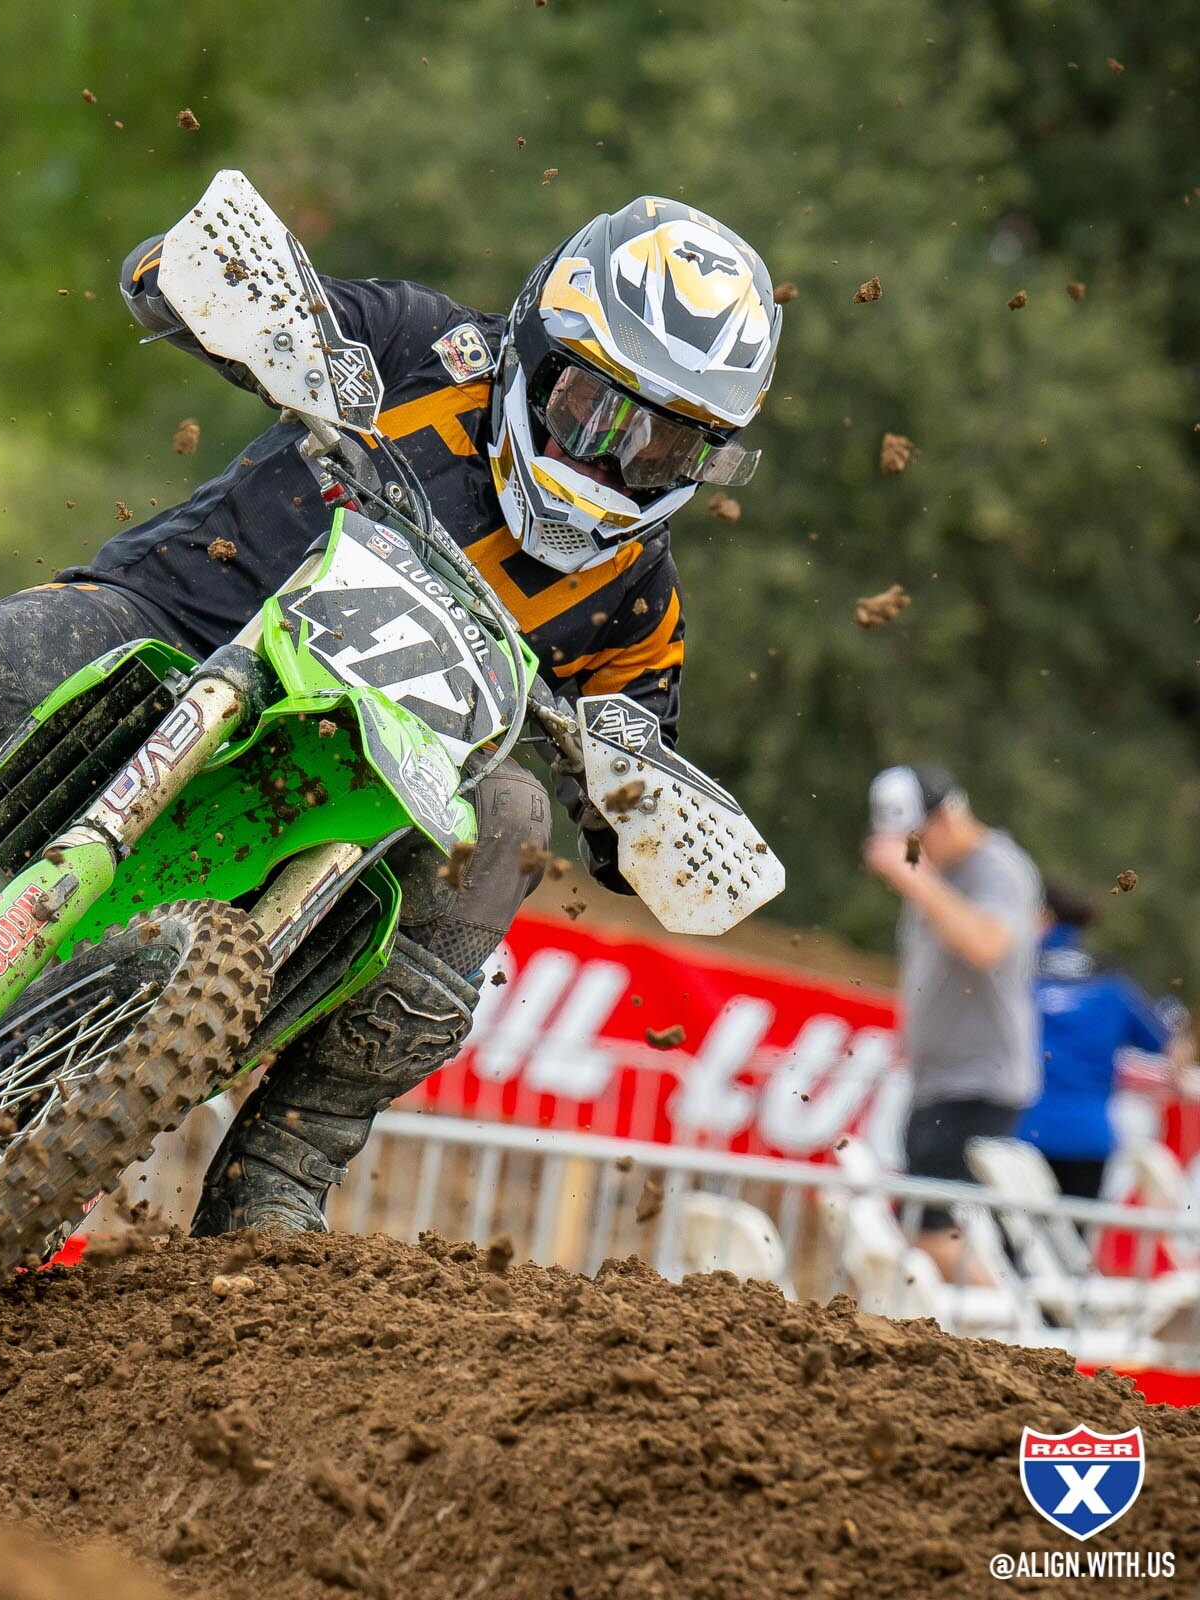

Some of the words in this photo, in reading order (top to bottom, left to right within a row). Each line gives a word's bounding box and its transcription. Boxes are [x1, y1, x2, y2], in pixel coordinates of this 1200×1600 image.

[455, 330, 488, 369] 50
[294, 586, 495, 744] 472
[395, 559, 467, 621] LUCAS
[462, 624, 490, 666] OIL
